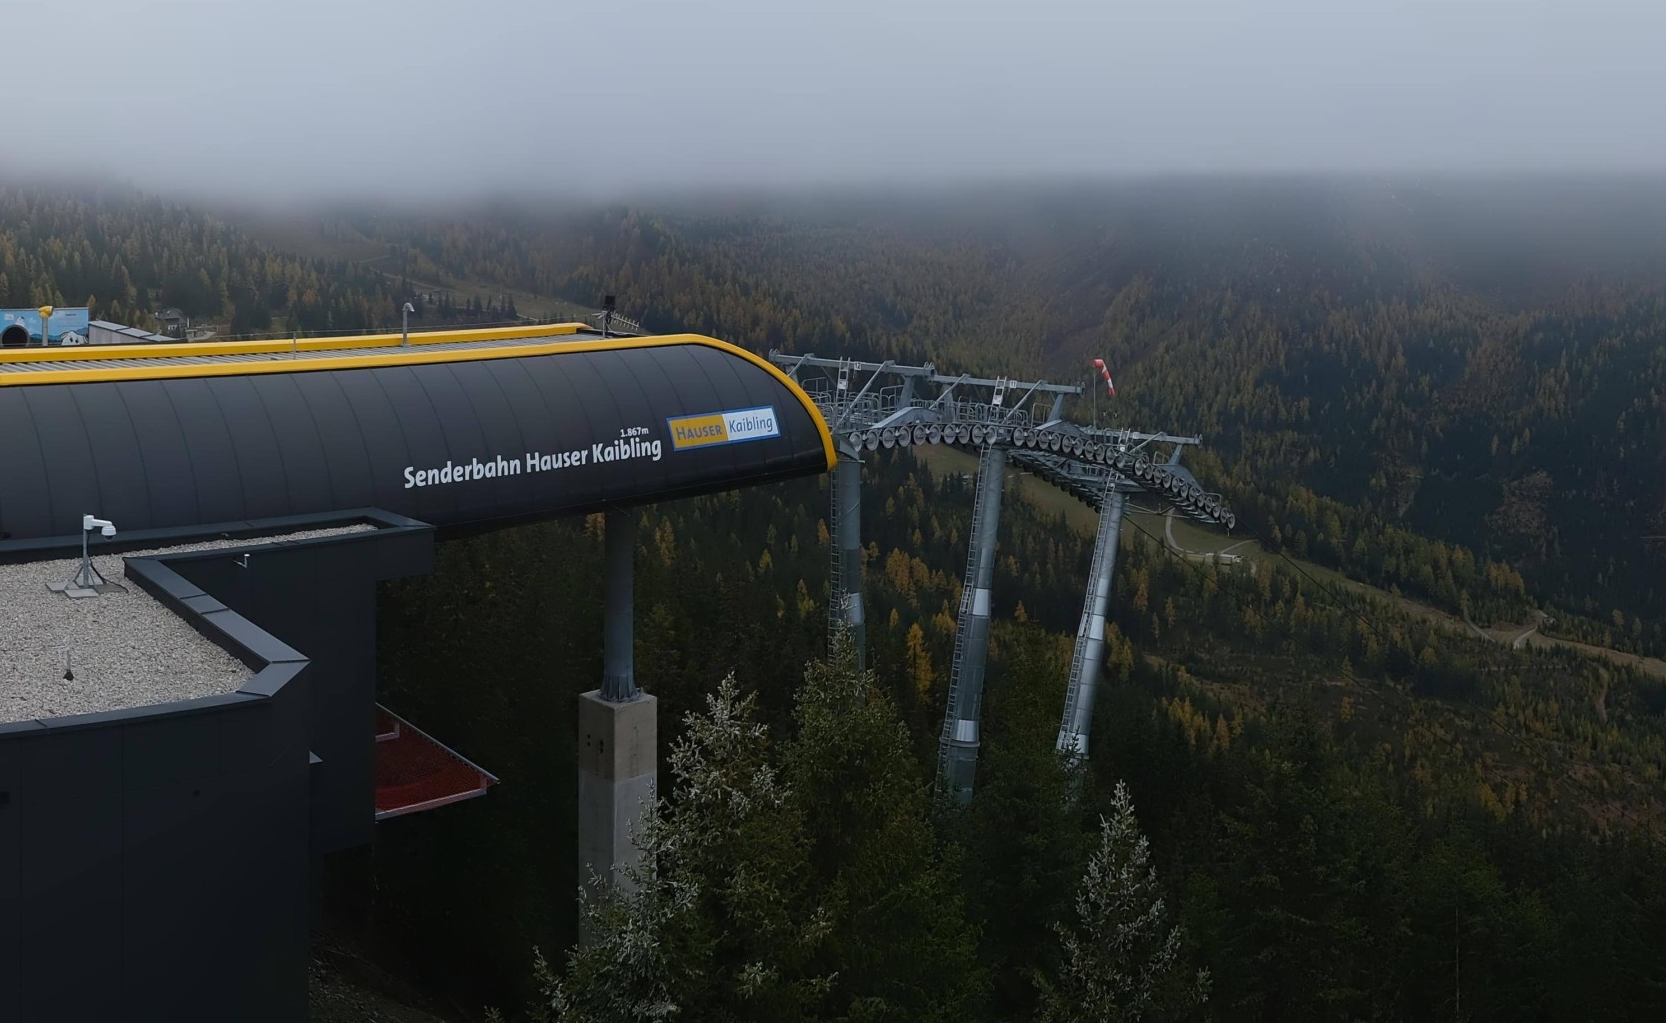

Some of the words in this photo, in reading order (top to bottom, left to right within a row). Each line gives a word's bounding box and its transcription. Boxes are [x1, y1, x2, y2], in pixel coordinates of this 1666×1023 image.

[676, 425, 723, 440] HAUSER
[729, 416, 773, 433] Kaibling
[404, 455, 521, 489] Senderbahn
[526, 448, 589, 473] Hauser
[592, 436, 662, 463] Kaibling
